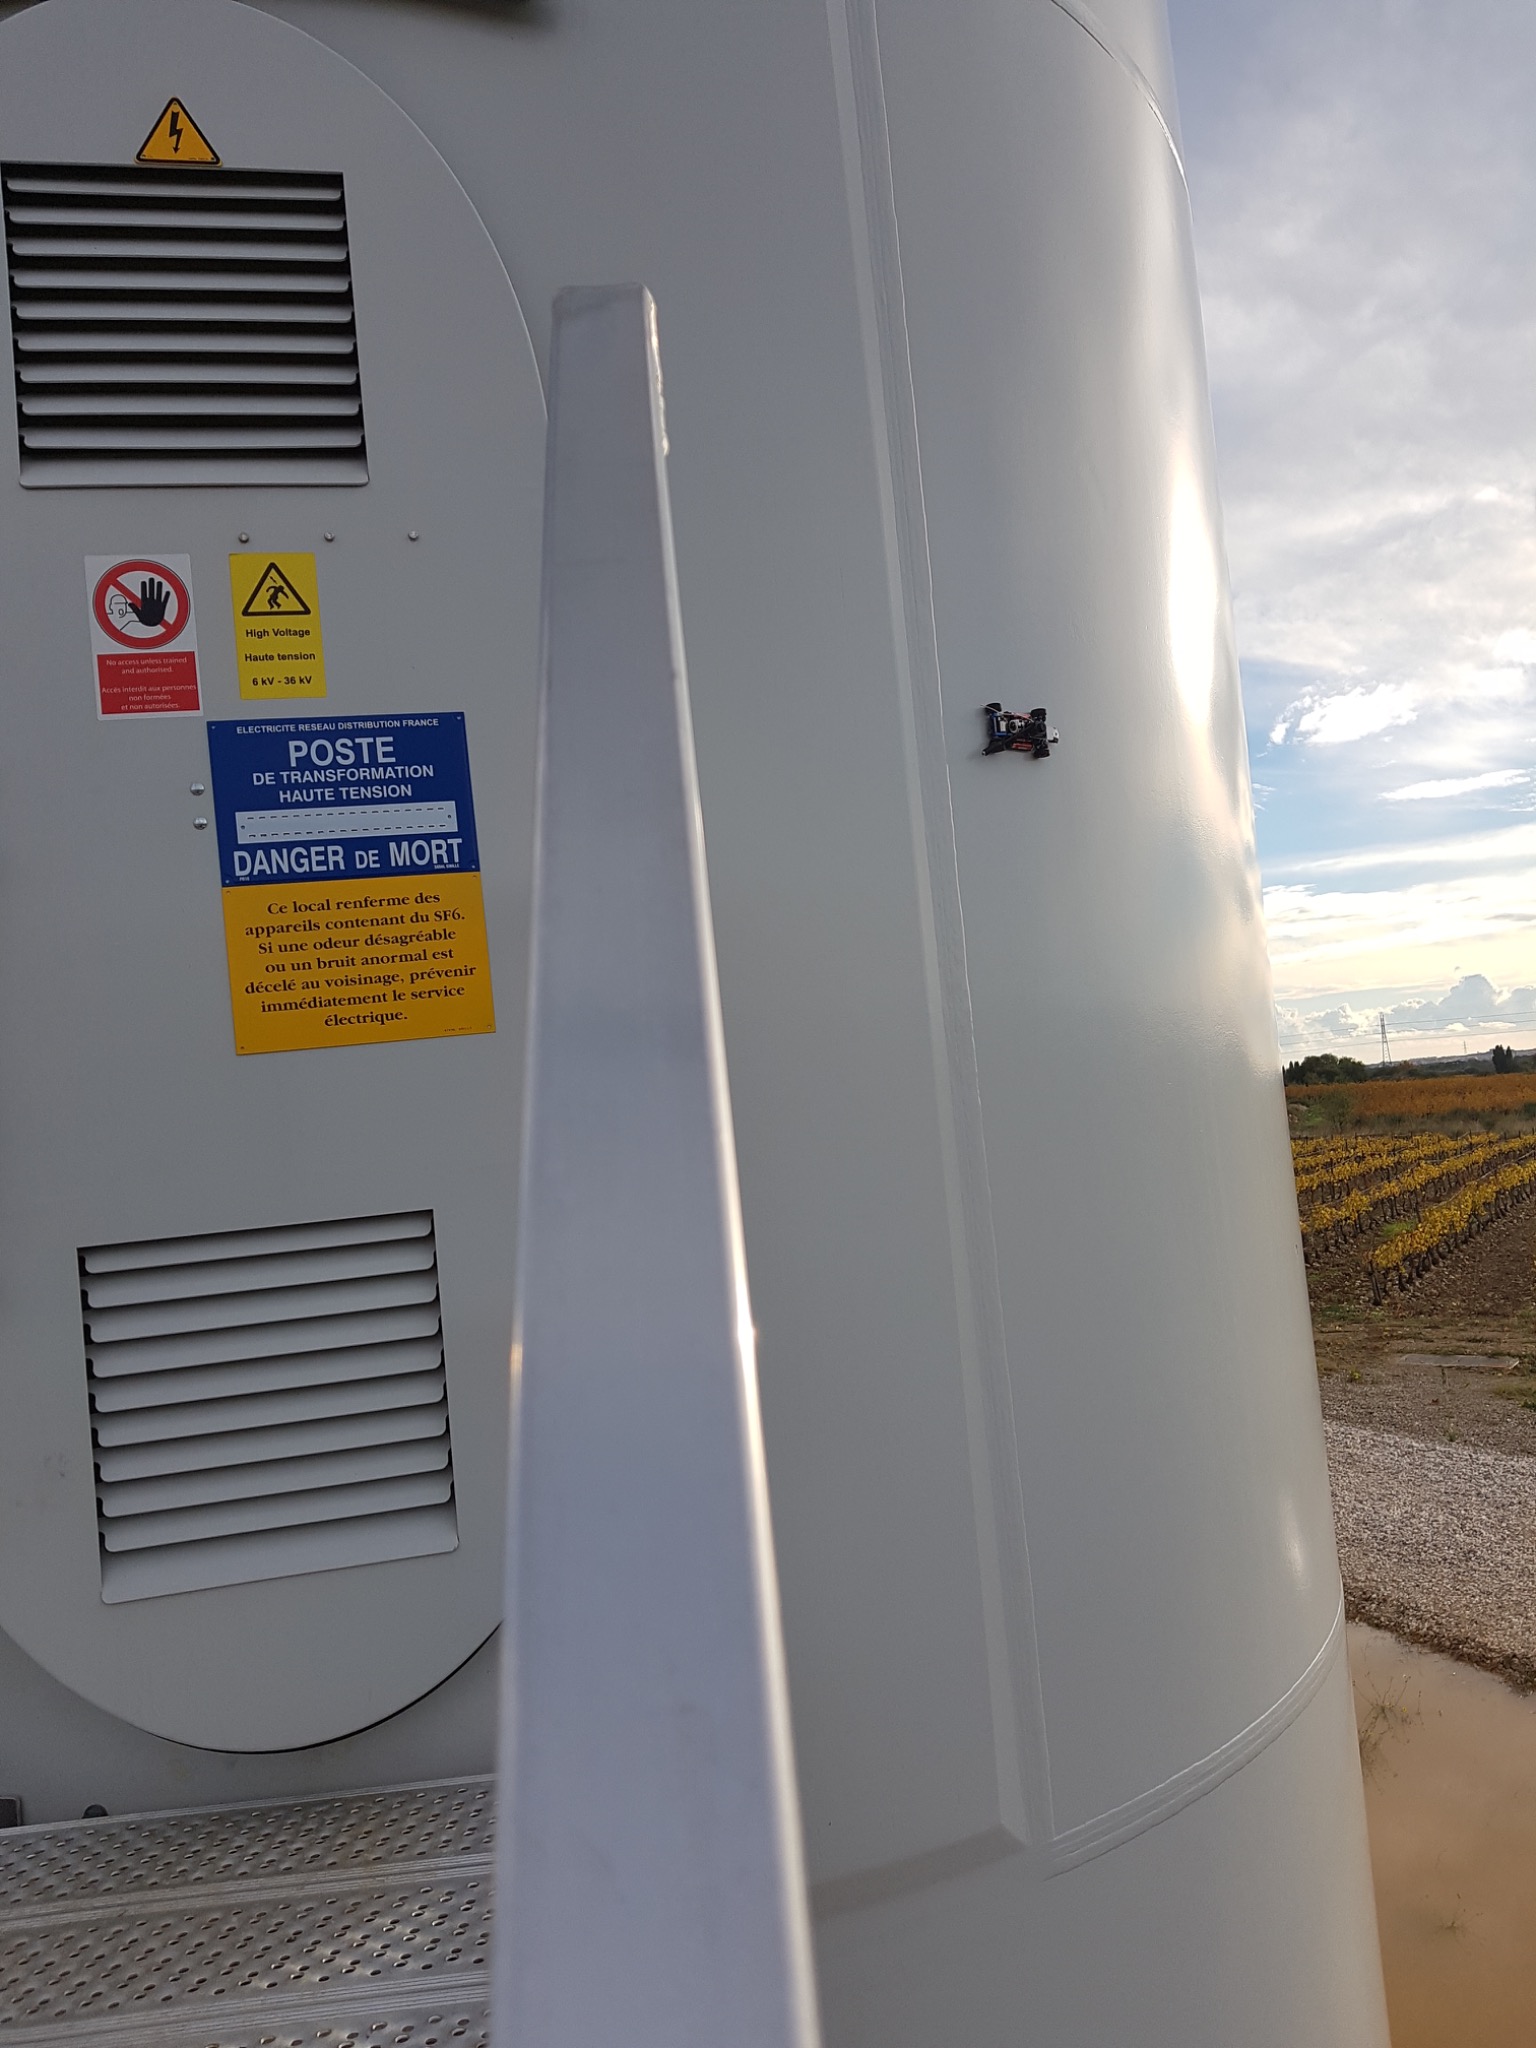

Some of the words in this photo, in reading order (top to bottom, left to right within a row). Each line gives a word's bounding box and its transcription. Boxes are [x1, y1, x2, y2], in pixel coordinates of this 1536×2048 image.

[245, 628, 269, 639] High
[271, 628, 311, 637] Voltage
[245, 652, 274, 662] Haute
[277, 652, 316, 661] tension
[252, 677, 258, 686] 6
[261, 677, 275, 686] kV
[284, 676, 297, 686] 36
[299, 676, 312, 685] kV
[236, 724, 296, 734] ELECTRICITE
[298, 722, 336, 732] RESEAU
[338, 719, 400, 730] DISTRIBUTION
[402, 718, 439, 728] FRANCE
[288, 736, 396, 767] POSTE
[253, 772, 275, 786] DE
[280, 765, 434, 784] TRANSFORMATION
[279, 788, 335, 803] HAUTE
[339, 784, 412, 800] TENSION
[233, 845, 345, 877] DANGER
[355, 850, 380, 870] DE
[389, 838, 463, 867] MORT
[267, 902, 288, 915] Ce
[293, 899, 330, 914] local
[335, 896, 410, 910] renferme
[414, 892, 440, 905] des
[245, 919, 320, 939] appareils
[325, 914, 405, 930] contenant
[409, 911, 429, 923] du
[434, 907, 465, 921] SF6.
[258, 942, 273, 955] Si
[277, 941, 308, 953] une
[313, 937, 360, 950] odeur
[364, 928, 456, 947] désagréable
[265, 962, 286, 974] ou
[290, 960, 312, 972] un
[316, 955, 356, 970] bruit
[361, 949, 427, 966] anormal
[432, 948, 454, 960] est
[245, 978, 296, 995] décelé
[301, 978, 320, 990] au
[324, 973, 405, 989] voisinage,
[409, 964, 477, 984] prévenir
[261, 993, 388, 1013] immédiatement
[392, 989, 406, 1002] le
[411, 986, 465, 1000] service
[324, 1011, 408, 1027] électrique.
